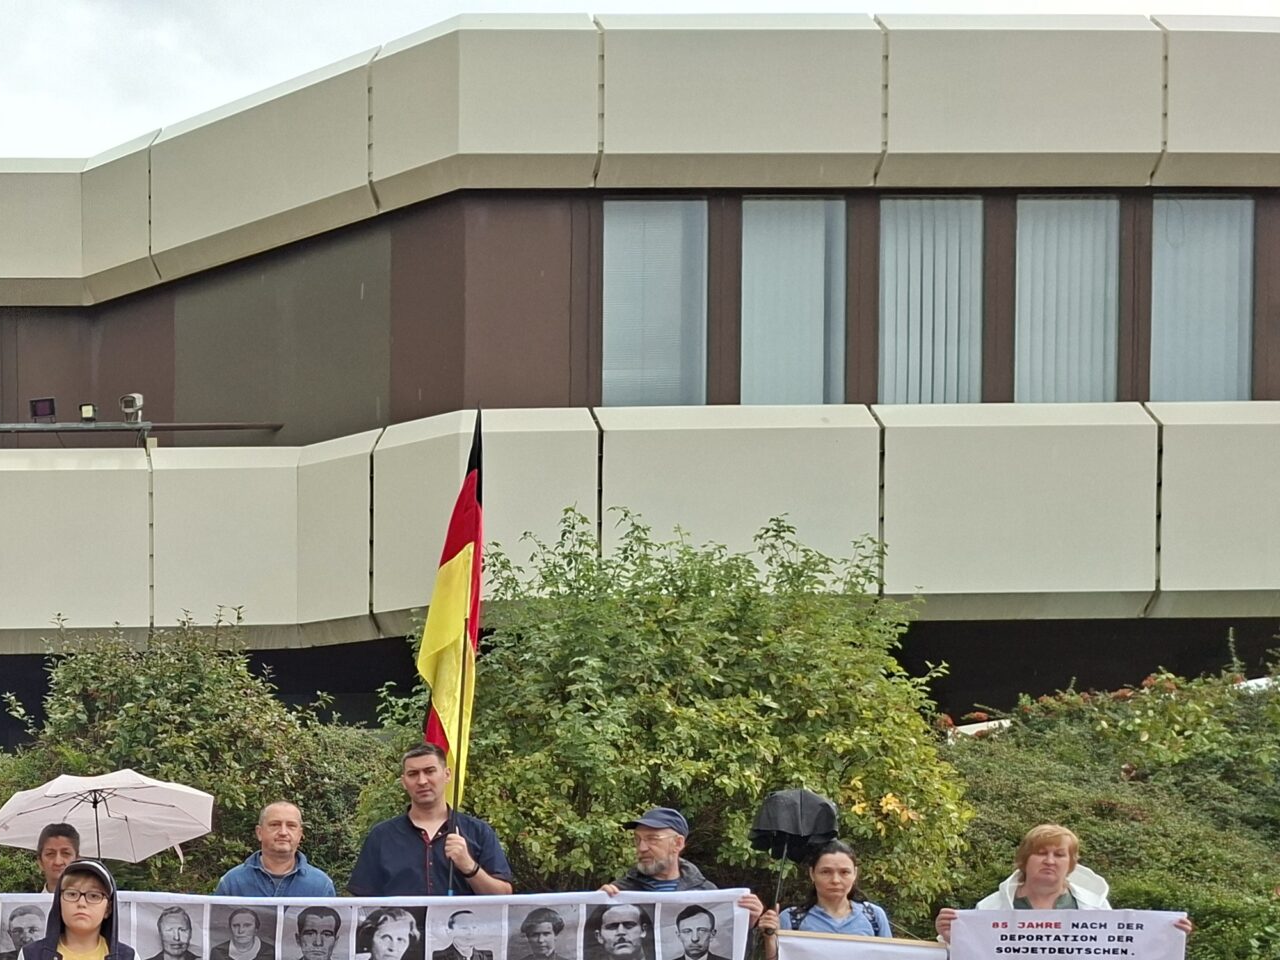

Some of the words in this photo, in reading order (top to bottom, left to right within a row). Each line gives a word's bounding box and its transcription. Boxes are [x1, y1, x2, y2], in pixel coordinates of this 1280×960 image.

[1000, 934, 1097, 942] DEPORTATION
[1108, 935, 1133, 943] DER
[996, 947, 1134, 955] SOWJETDEUTSCHEN.
